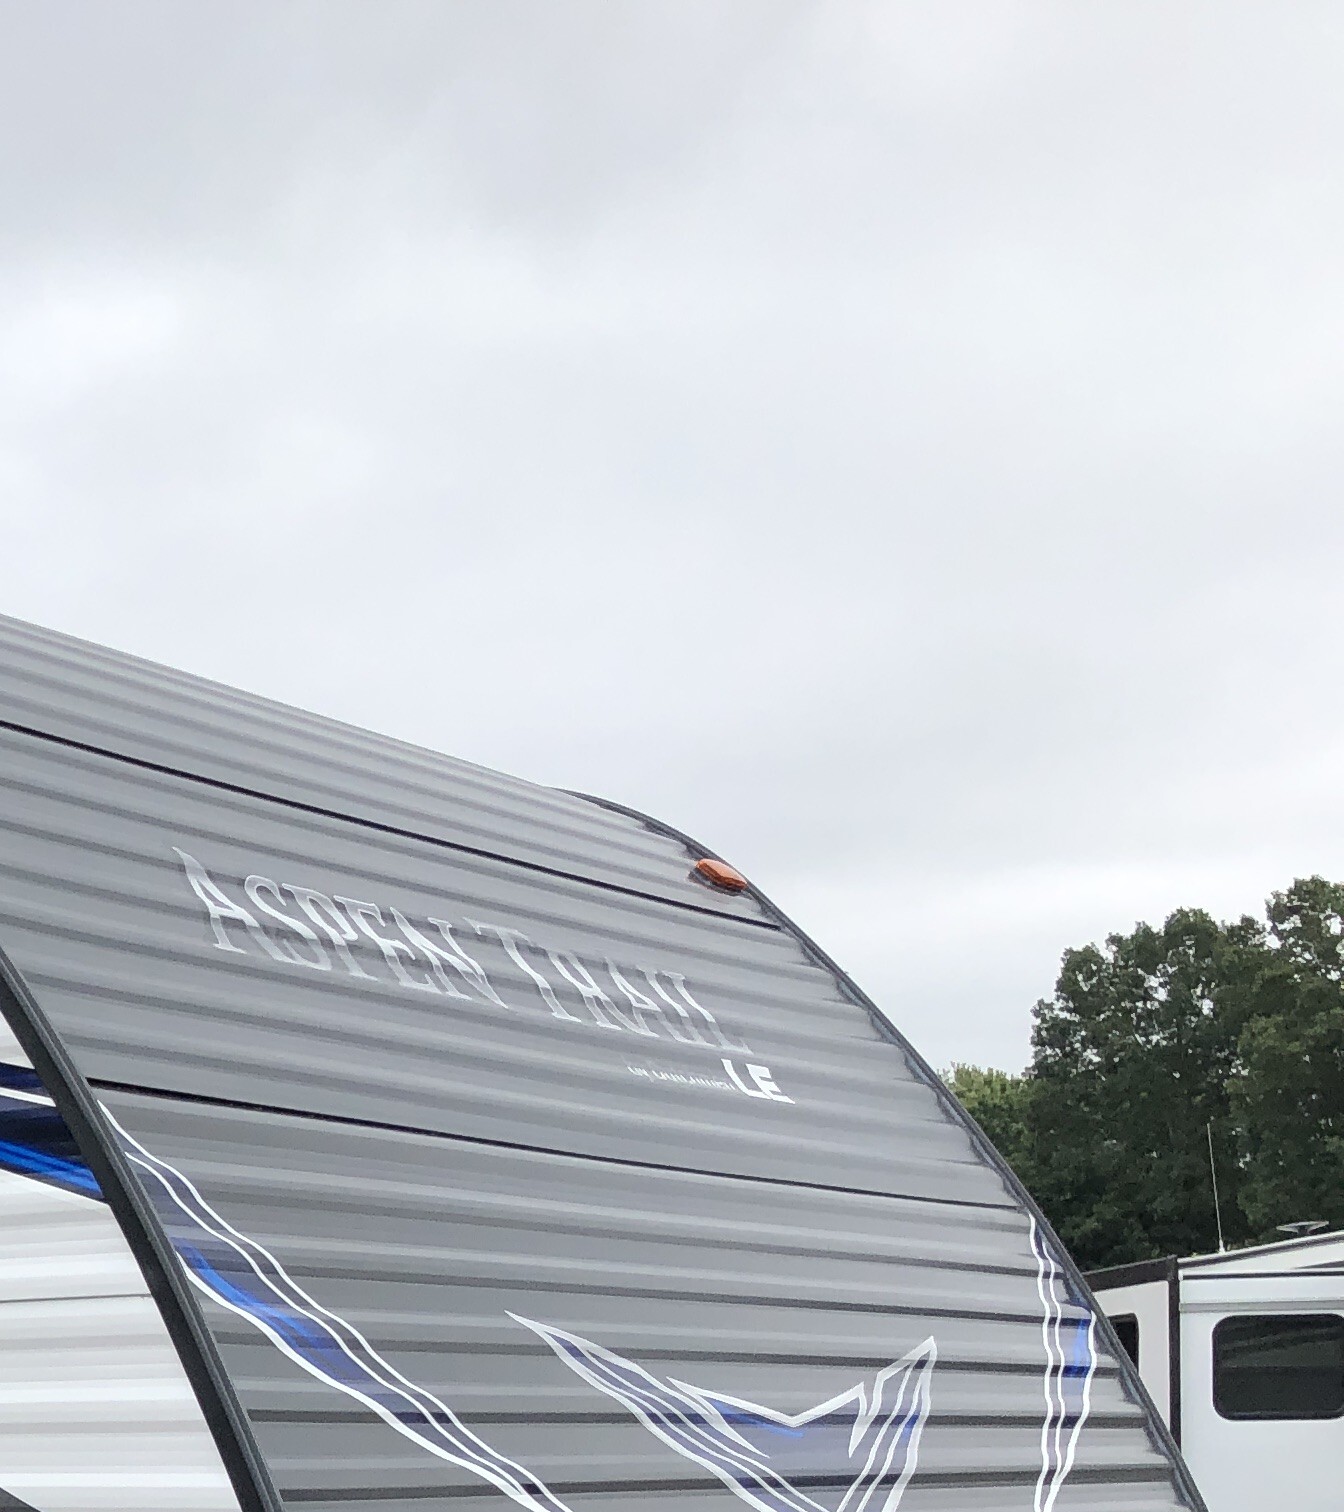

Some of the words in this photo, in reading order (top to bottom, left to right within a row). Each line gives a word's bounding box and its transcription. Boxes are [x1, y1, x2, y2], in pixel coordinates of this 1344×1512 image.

[172, 846, 508, 1009] ASPEN
[464, 916, 752, 1056] TRAIL
[720, 1058, 796, 1105] LE
